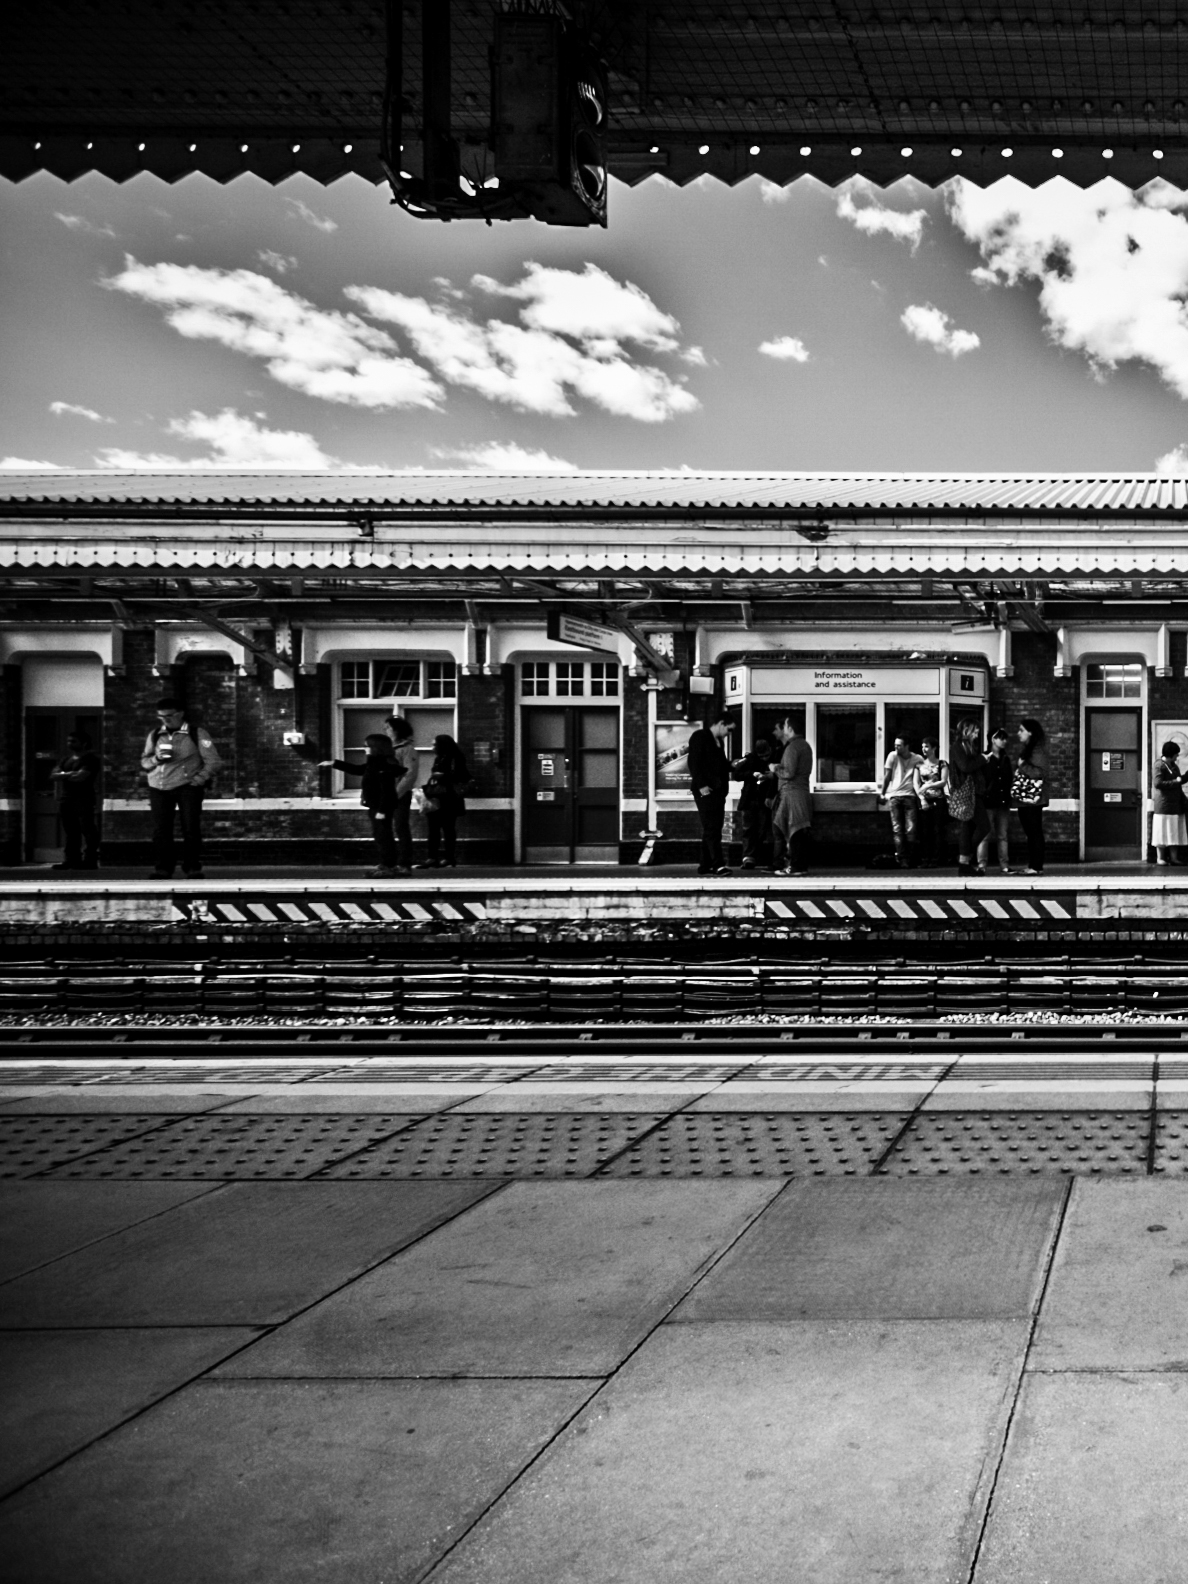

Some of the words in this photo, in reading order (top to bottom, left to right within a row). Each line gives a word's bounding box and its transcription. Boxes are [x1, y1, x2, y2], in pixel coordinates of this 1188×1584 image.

[428, 1067, 586, 1082] GAP
[594, 1067, 730, 1081] THE
[757, 1066, 943, 1080] MIND
